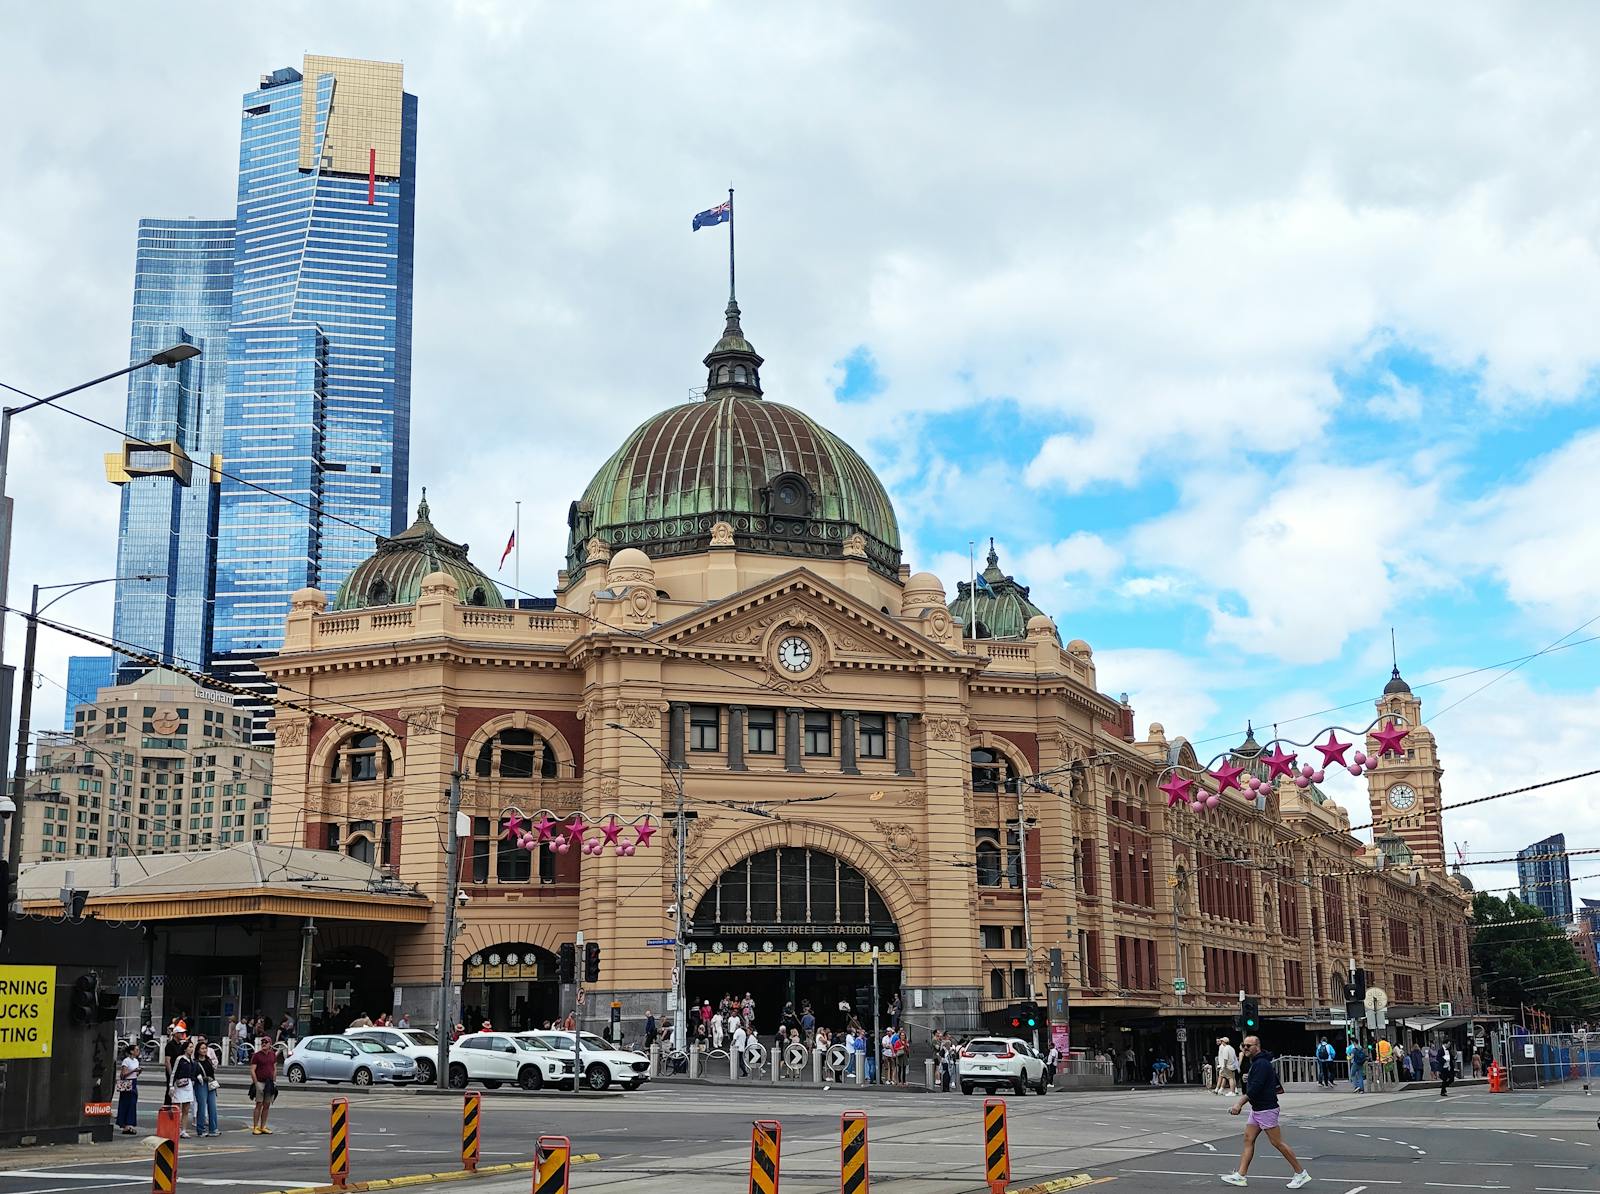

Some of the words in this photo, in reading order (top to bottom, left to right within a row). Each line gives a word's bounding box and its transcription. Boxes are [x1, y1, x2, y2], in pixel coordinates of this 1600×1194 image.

[195, 687, 234, 704] Langham
[720, 925, 768, 934] FLINDERS
[780, 925, 816, 934] STREET
[827, 925, 870, 934] STATION
[1, 1028, 37, 1042] TING
